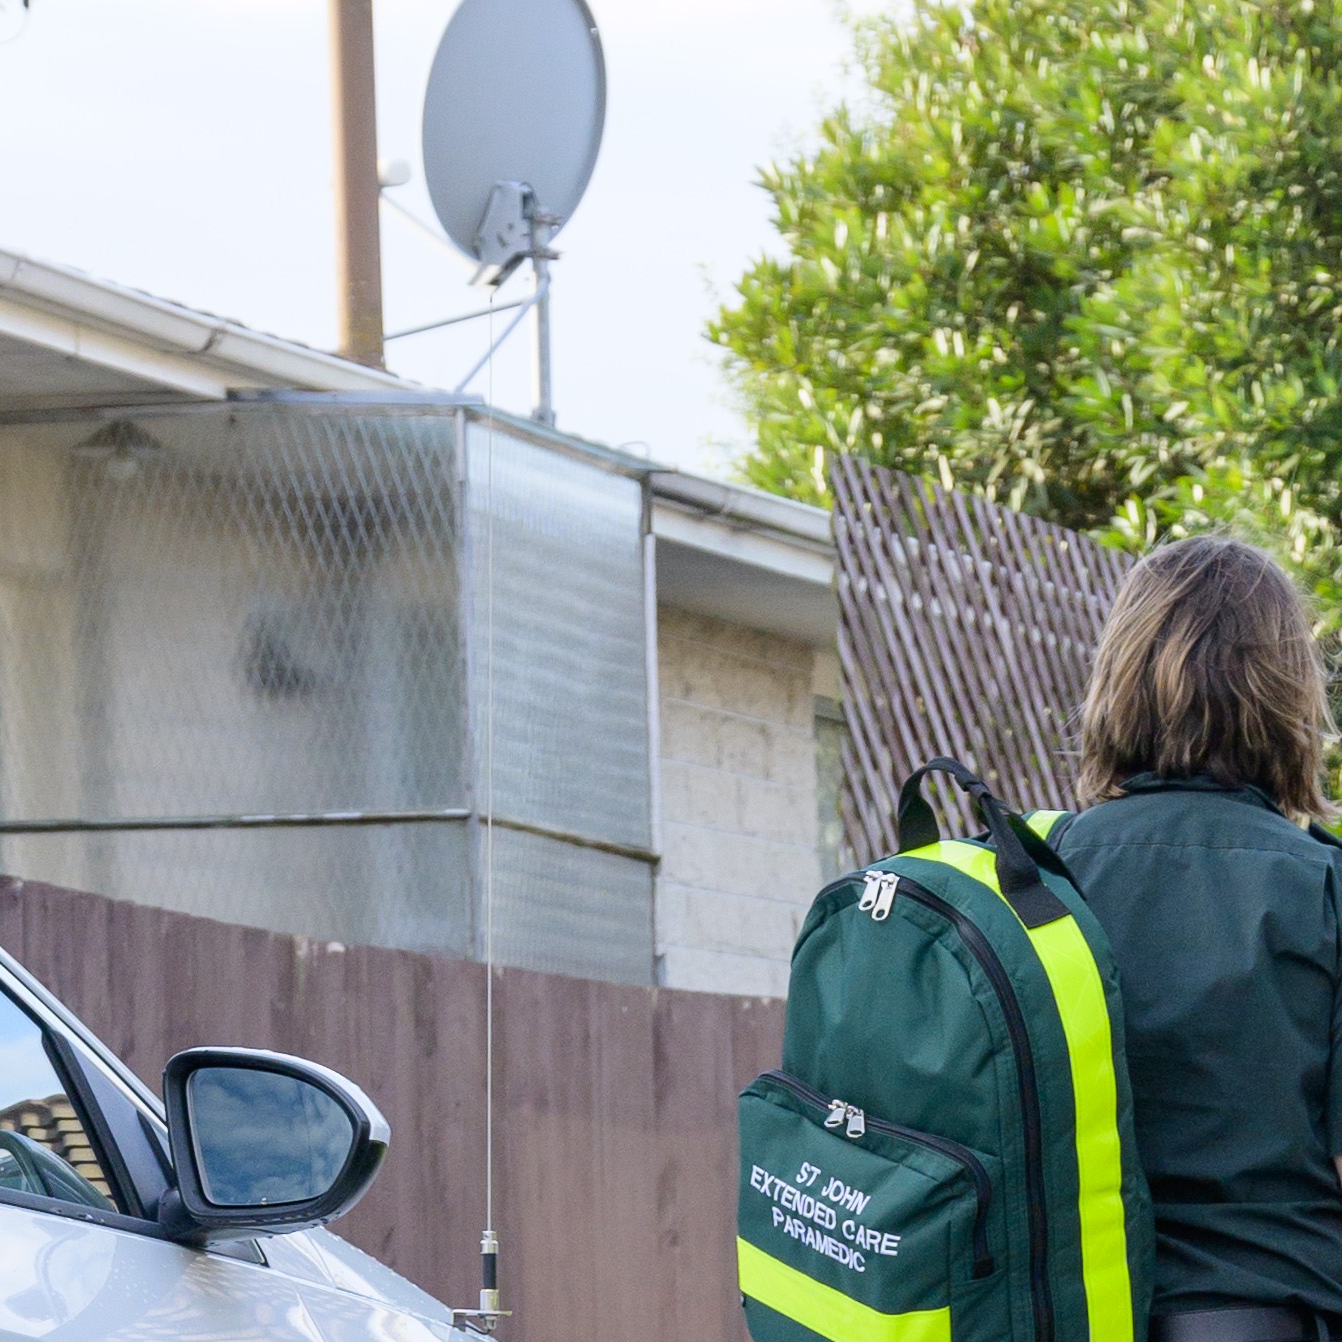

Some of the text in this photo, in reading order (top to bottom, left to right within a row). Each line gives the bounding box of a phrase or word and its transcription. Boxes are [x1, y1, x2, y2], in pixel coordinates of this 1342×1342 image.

[750, 1164, 901, 1257] EXTENDED CARE
[795, 1161, 871, 1215] ST JOHN
[771, 1206, 866, 1273] PARAMEDIC
